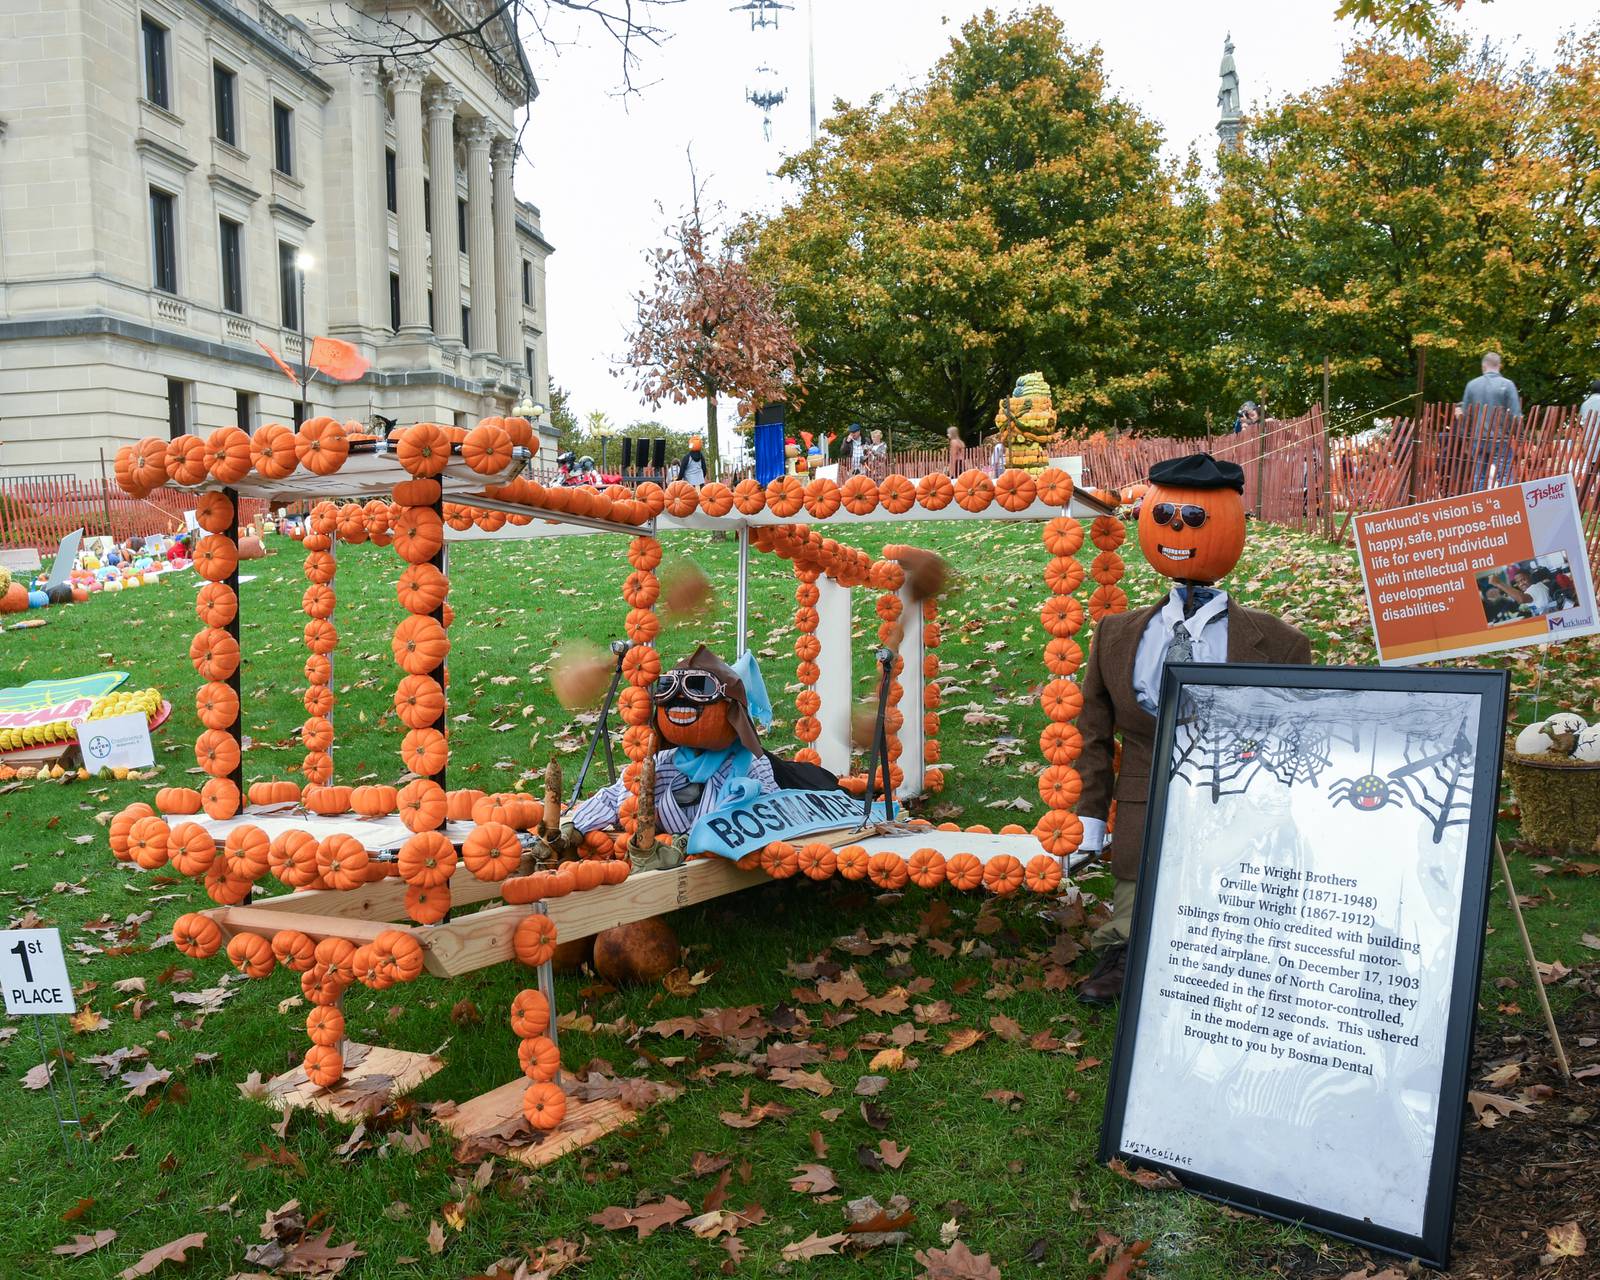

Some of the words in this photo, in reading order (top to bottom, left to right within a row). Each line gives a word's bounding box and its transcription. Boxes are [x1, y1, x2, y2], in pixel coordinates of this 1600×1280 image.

[1526, 482, 1566, 508] Fisher
[1365, 512, 1429, 535] Marklund's
[1432, 505, 1469, 521] vision
[1472, 501, 1483, 513] is
[1368, 537, 1407, 552] happy,
[1408, 530, 1436, 545] safe,
[1437, 512, 1521, 540] purpose-filled
[1371, 556, 1389, 569] life
[1392, 553, 1409, 567] for
[1413, 547, 1445, 562] every
[1448, 533, 1508, 555] individual
[1375, 573, 1400, 586] with
[1403, 559, 1468, 582] intellectual
[1472, 555, 1494, 569] and
[1379, 578, 1465, 604] developmental
[1549, 615, 1592, 631] Marklund
[1240, 863, 1260, 874] The
[1264, 866, 1302, 881] Wright
[1306, 871, 1357, 887] Brothers
[1218, 894, 1255, 908] Wilbur
[1259, 900, 1297, 916] Wright
[1301, 906, 1375, 928] (1867-1912)
[1220, 878, 1257, 891] Orville
[1261, 883, 1299, 898] Wright
[1303, 888, 1377, 910] (1871-1948)
[1178, 905, 1219, 922] Siblings
[1223, 912, 1249, 925] from
[1254, 917, 1280, 930] Ohio
[1284, 924, 1332, 938] credited
[1337, 931, 1362, 943] with
[1367, 933, 1420, 954] building
[1188, 926, 1208, 936] and
[1212, 927, 1243, 944] flying
[1247, 933, 1264, 945] the
[1268, 936, 1291, 949] first
[1294, 942, 1355, 960] successful
[1359, 953, 1401, 966] motor-
[11, 940, 43, 982] 1st
[1171, 940, 1217, 954] operated
[1221, 947, 1270, 964] airplane.
[1279, 956, 1294, 968] On
[1299, 959, 1360, 979] December
[1365, 971, 1382, 985] 17,
[1388, 975, 1419, 989] 1903
[13, 989, 63, 1004] PLACE
[1169, 954, 1178, 965] in
[1182, 957, 1198, 968] the
[1202, 962, 1235, 977] sandy
[1238, 967, 1271, 981] dunes
[1275, 974, 1288, 984] of
[1290, 976, 1324, 991] North
[1329, 983, 1383, 1004] Carolina,
[1389, 993, 1417, 1010] they
[1160, 988, 1210, 1005] sustained
[1213, 997, 1242, 1012] flight
[1246, 1004, 1258, 1014] of
[1261, 1006, 1274, 1018] 12
[1278, 1012, 1328, 1029] seconds.
[1338, 1021, 1363, 1035] This
[1368, 1029, 1419, 1047] ushered
[1174, 974, 1229, 991] succeeded
[1233, 983, 1243, 994] in
[1247, 986, 1265, 998] the
[1269, 990, 1292, 1004] first
[1296, 997, 1404, 1027] motor-controlled,
[1184, 1025, 1229, 1044] Brought
[1232, 1037, 1242, 1047] to
[1245, 1041, 1266, 1051] you
[1271, 1043, 1285, 1058] by
[1288, 1048, 1328, 1066] Bosma
[1332, 1057, 1373, 1075] Dental
[1191, 1009, 1201, 1020] in
[1205, 1013, 1222, 1025] the
[1225, 1019, 1269, 1035] modern
[1273, 1030, 1292, 1042] age
[1297, 1032, 1310, 1043] of
[1313, 1037, 1365, 1055] aviation.
[1125, 1140, 1192, 1165] INSTACOLLAGE
